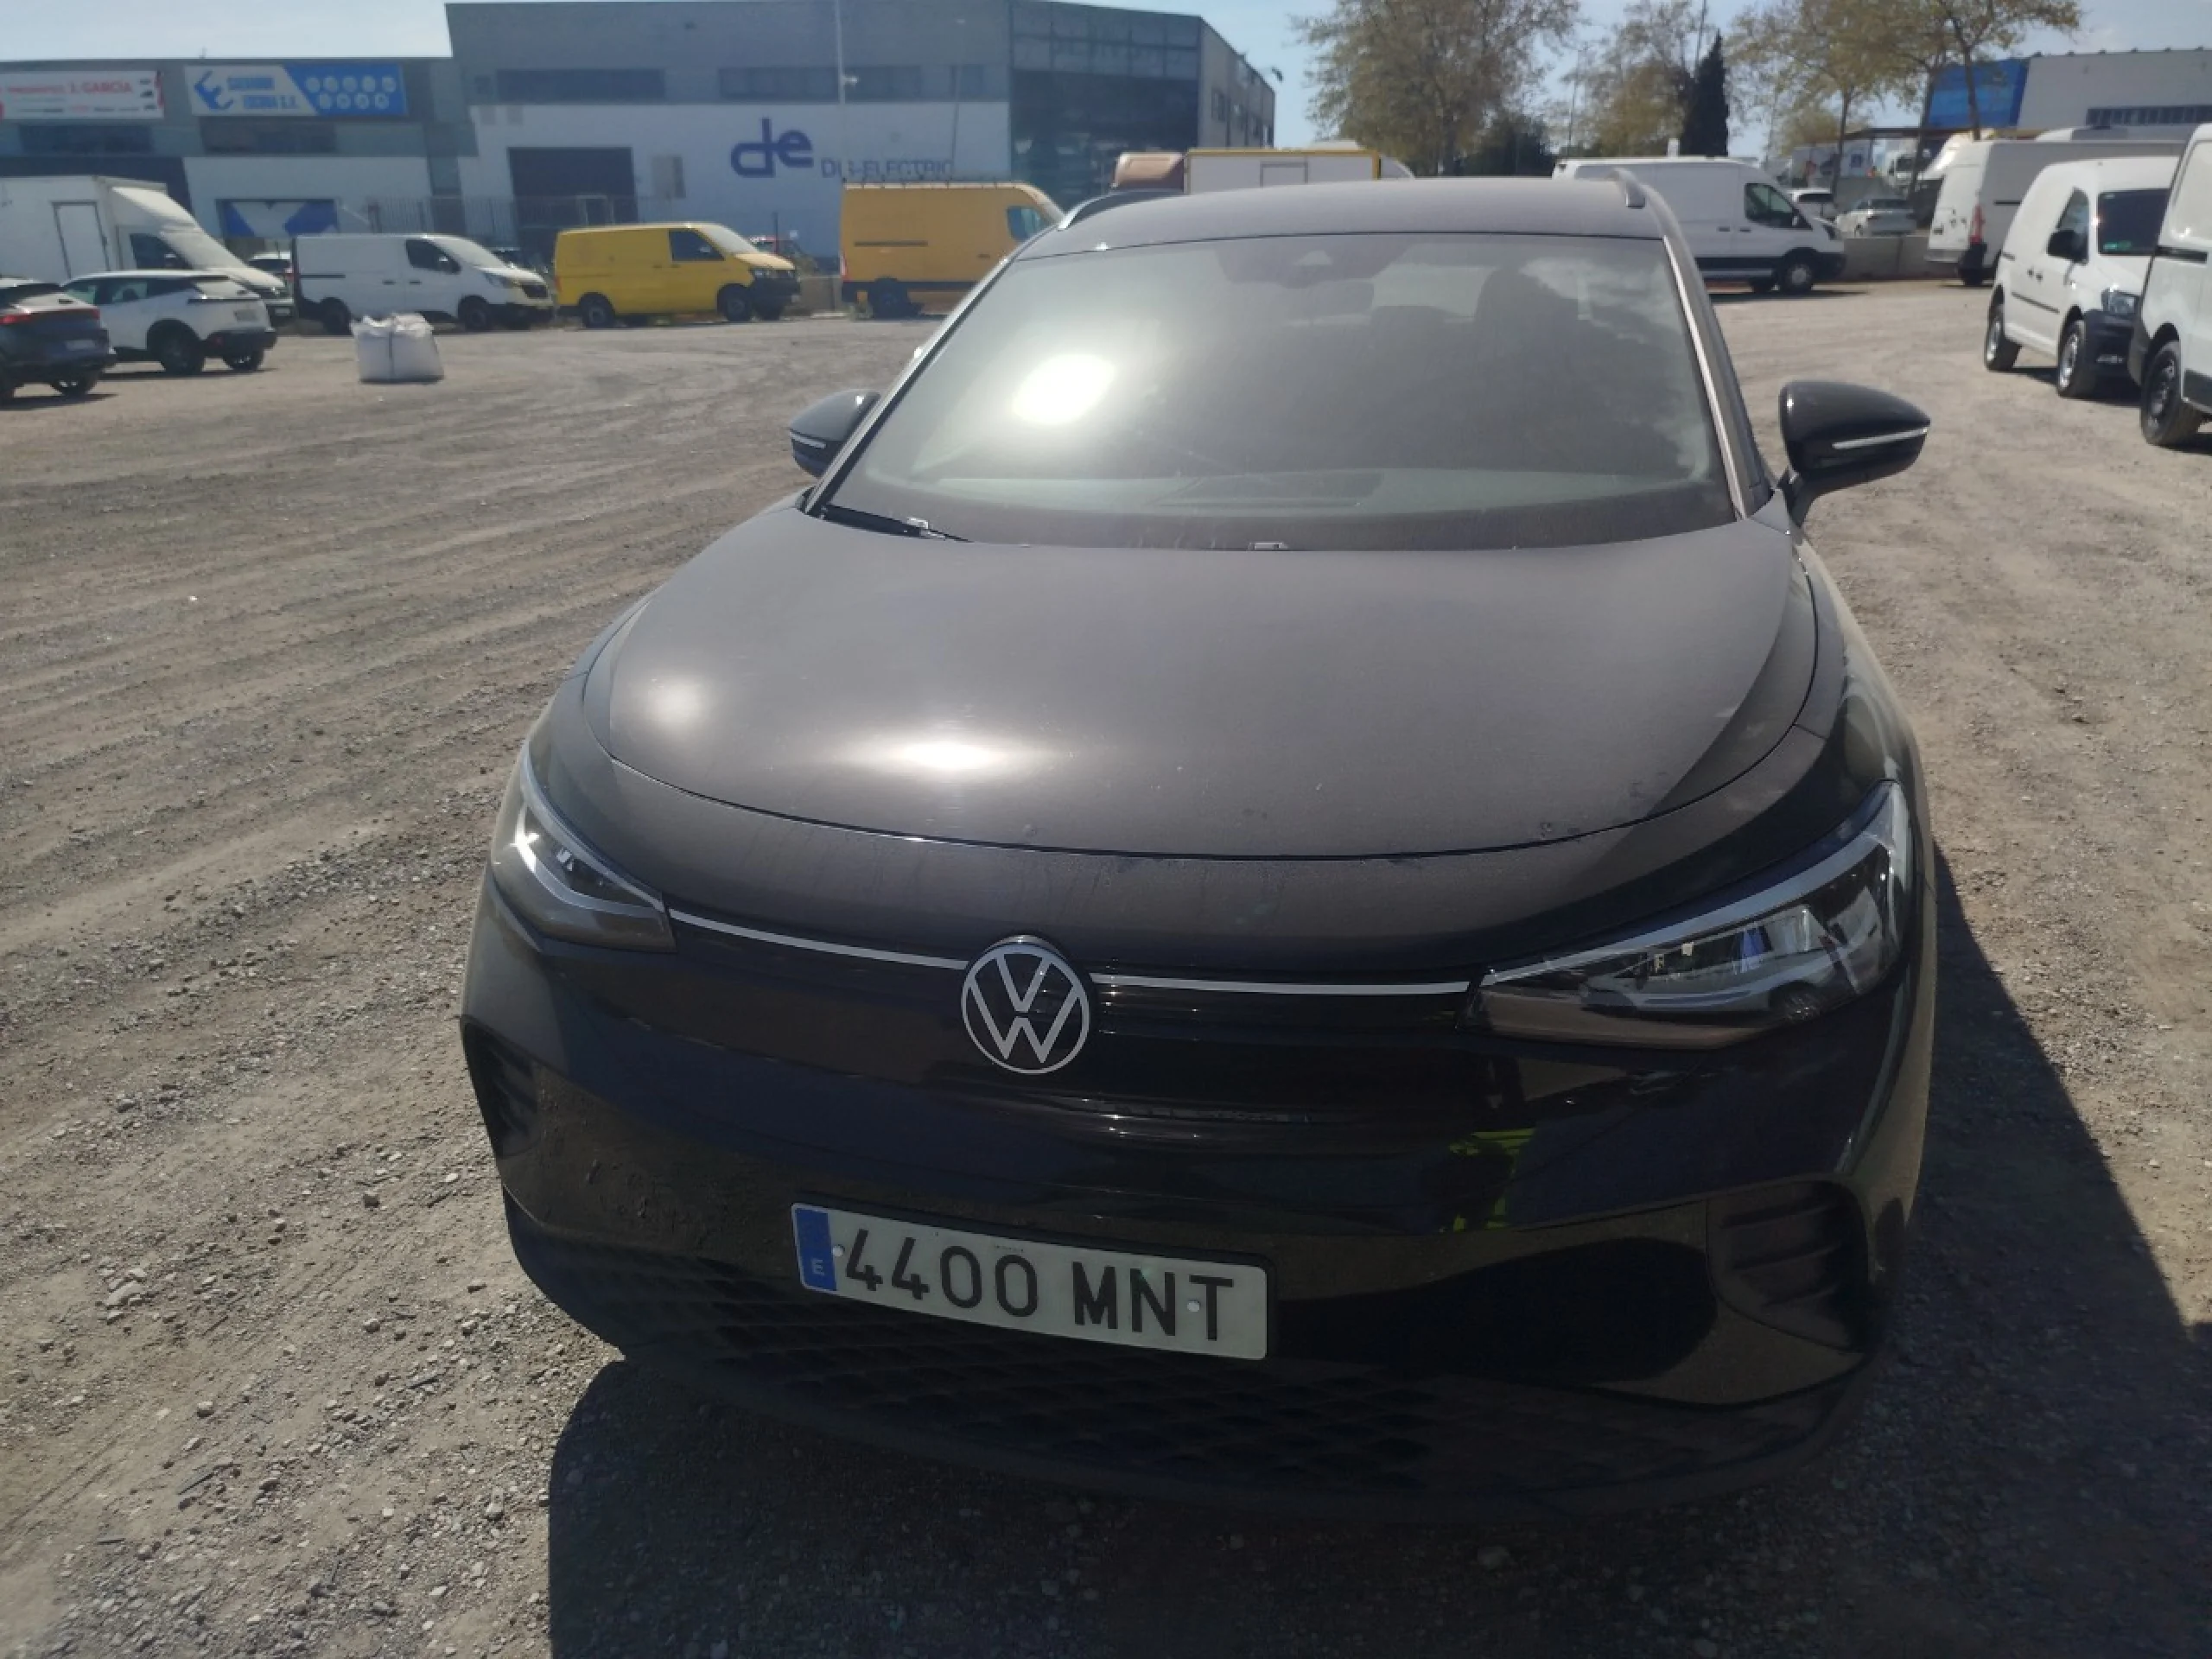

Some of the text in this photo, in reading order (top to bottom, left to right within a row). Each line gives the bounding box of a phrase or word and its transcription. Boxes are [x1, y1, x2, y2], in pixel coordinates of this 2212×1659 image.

[810, 1257, 825, 1277] E
[845, 1228, 1234, 1342] 4400 MNT
